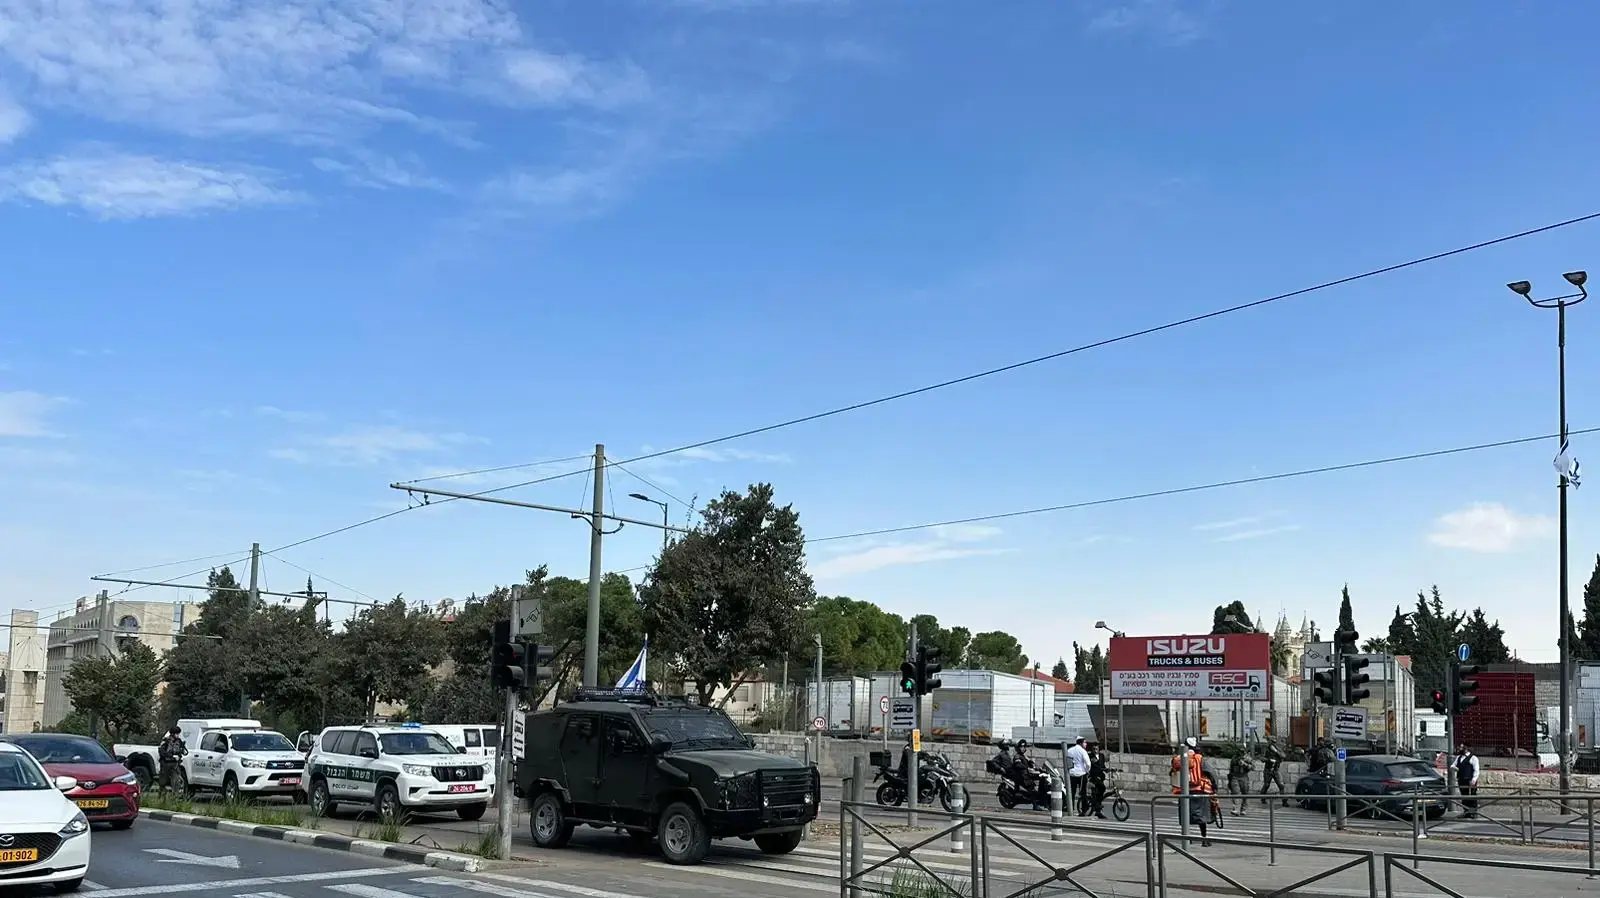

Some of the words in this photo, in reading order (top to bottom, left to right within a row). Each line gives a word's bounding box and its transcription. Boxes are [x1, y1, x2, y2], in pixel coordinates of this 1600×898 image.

[1147, 638, 1225, 655] ISUZU
[1149, 657, 1183, 666] TRUCKS
[1185, 657, 1192, 665] &
[1194, 657, 1223, 665] BUSES
[1211, 673, 1244, 683] ASC
